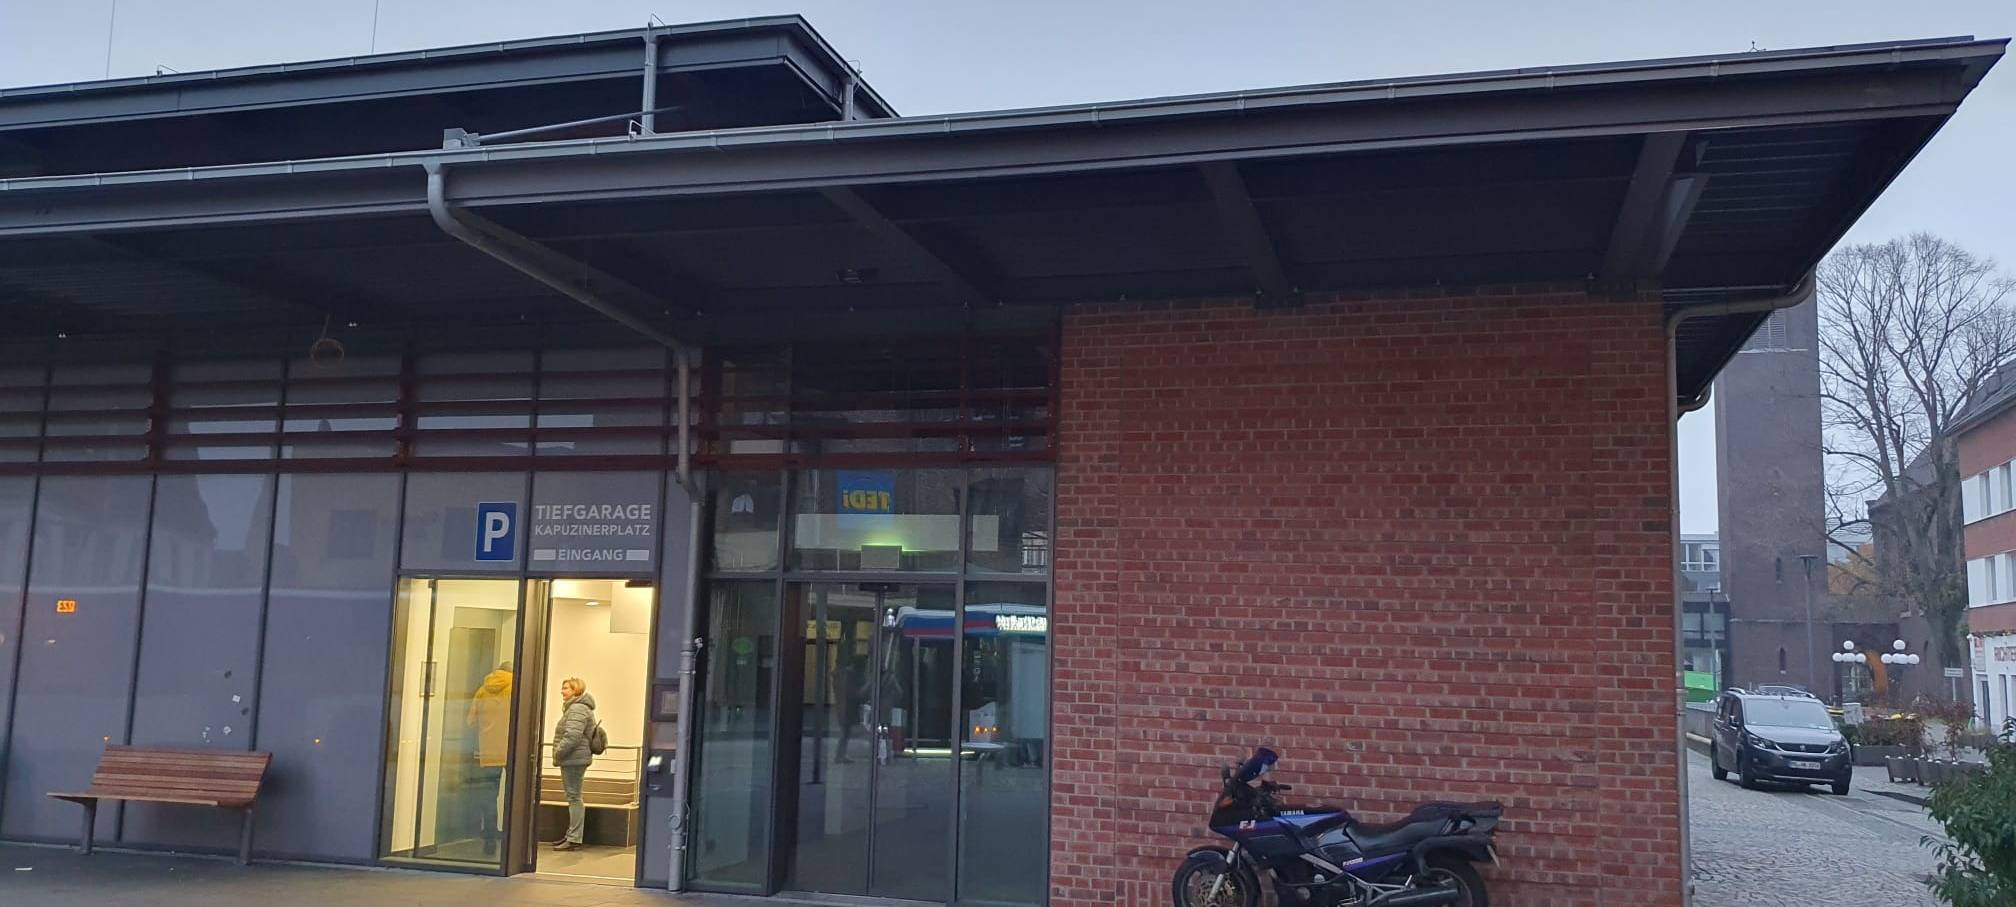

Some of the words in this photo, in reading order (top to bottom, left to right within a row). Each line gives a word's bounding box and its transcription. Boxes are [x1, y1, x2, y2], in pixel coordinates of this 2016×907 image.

[535, 503, 652, 520] TIEFGARAGE
[484, 512, 510, 553] P
[534, 525, 651, 537] KAPUZINERPLATZ
[558, 549, 624, 561] EINGANG
